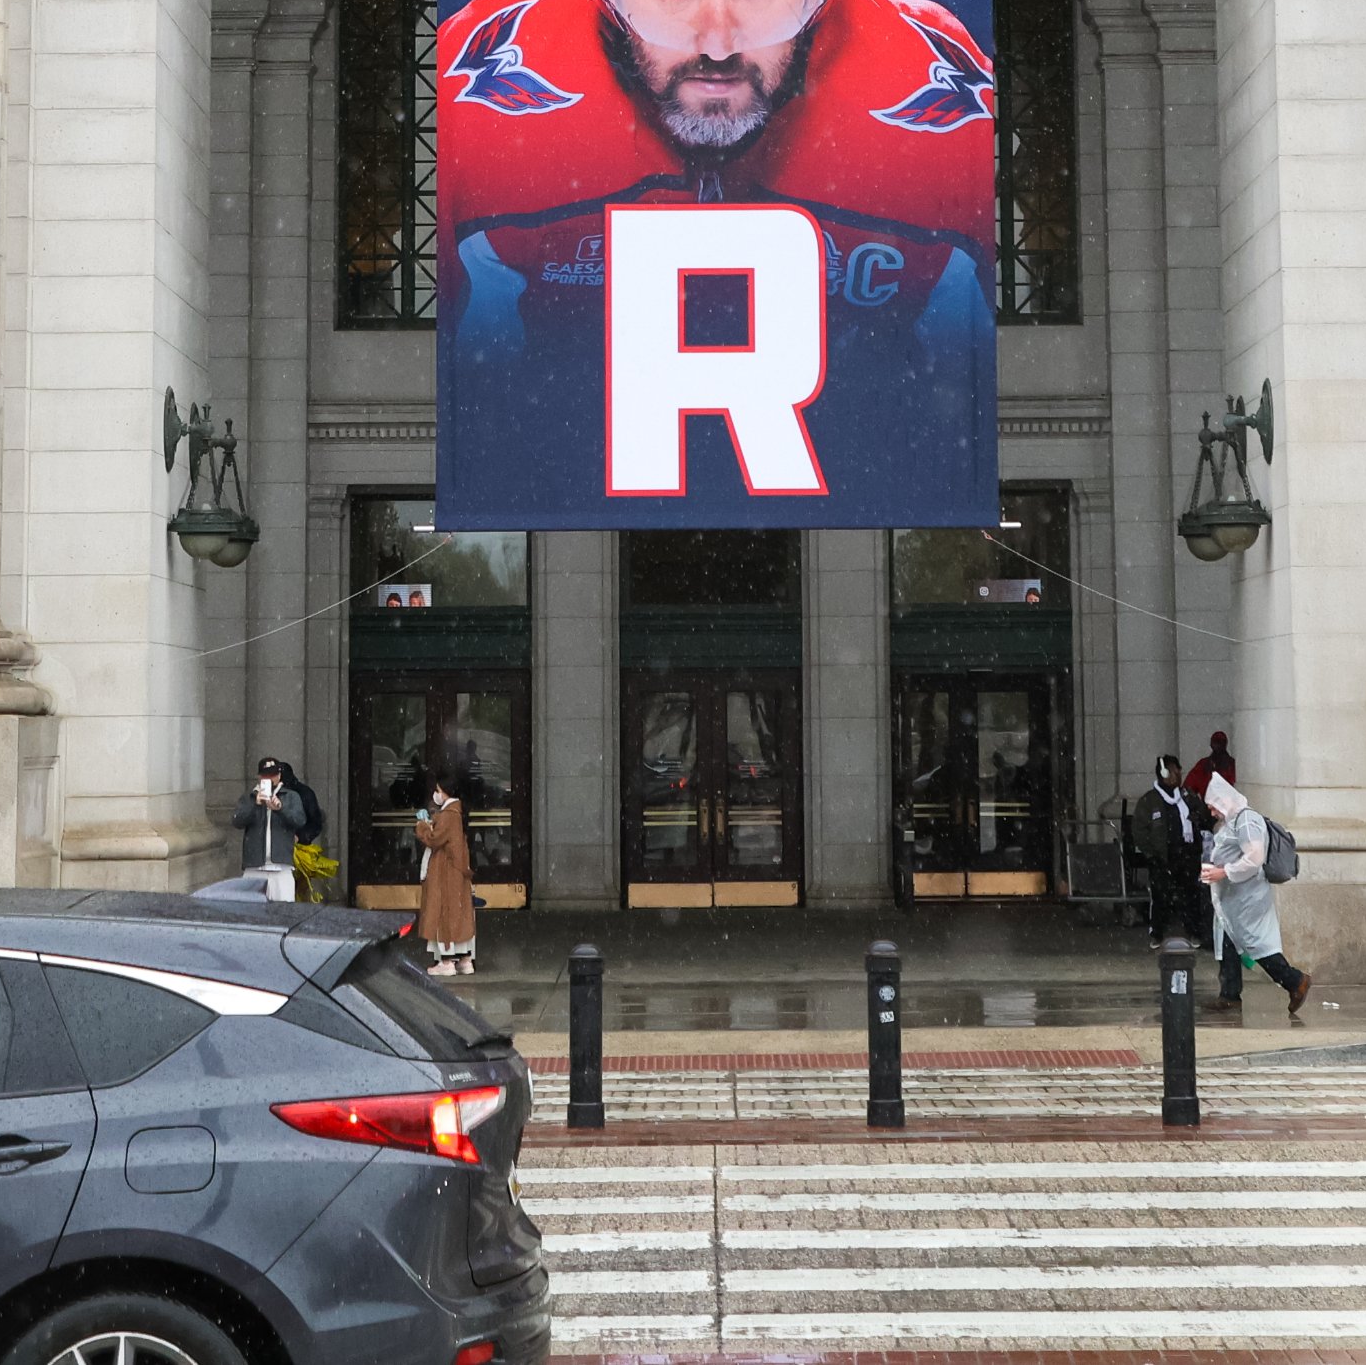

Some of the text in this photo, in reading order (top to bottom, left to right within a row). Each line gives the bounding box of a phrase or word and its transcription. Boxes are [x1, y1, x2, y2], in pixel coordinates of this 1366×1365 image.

[541, 272, 605, 286] SPORTSB
[544, 263, 605, 274] CAESA
[843, 242, 904, 306] C
[605, 203, 829, 497] R
